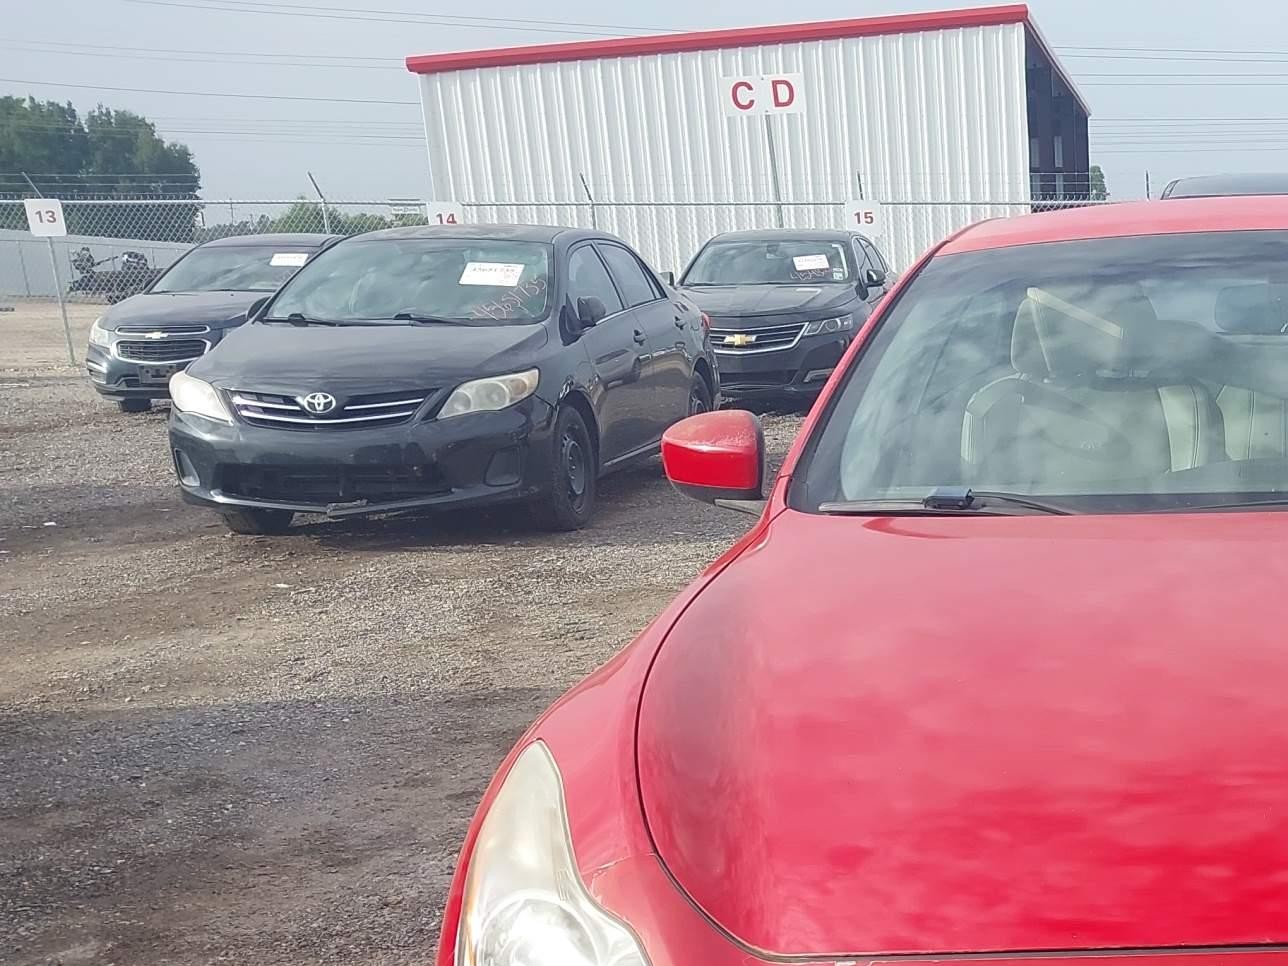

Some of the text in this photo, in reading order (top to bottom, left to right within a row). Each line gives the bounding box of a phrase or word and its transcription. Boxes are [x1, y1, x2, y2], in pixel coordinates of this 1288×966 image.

[731, 79, 795, 110] C D
[34, 209, 57, 224] 13
[436, 212, 458, 225] 14
[854, 211, 874, 225] 15
